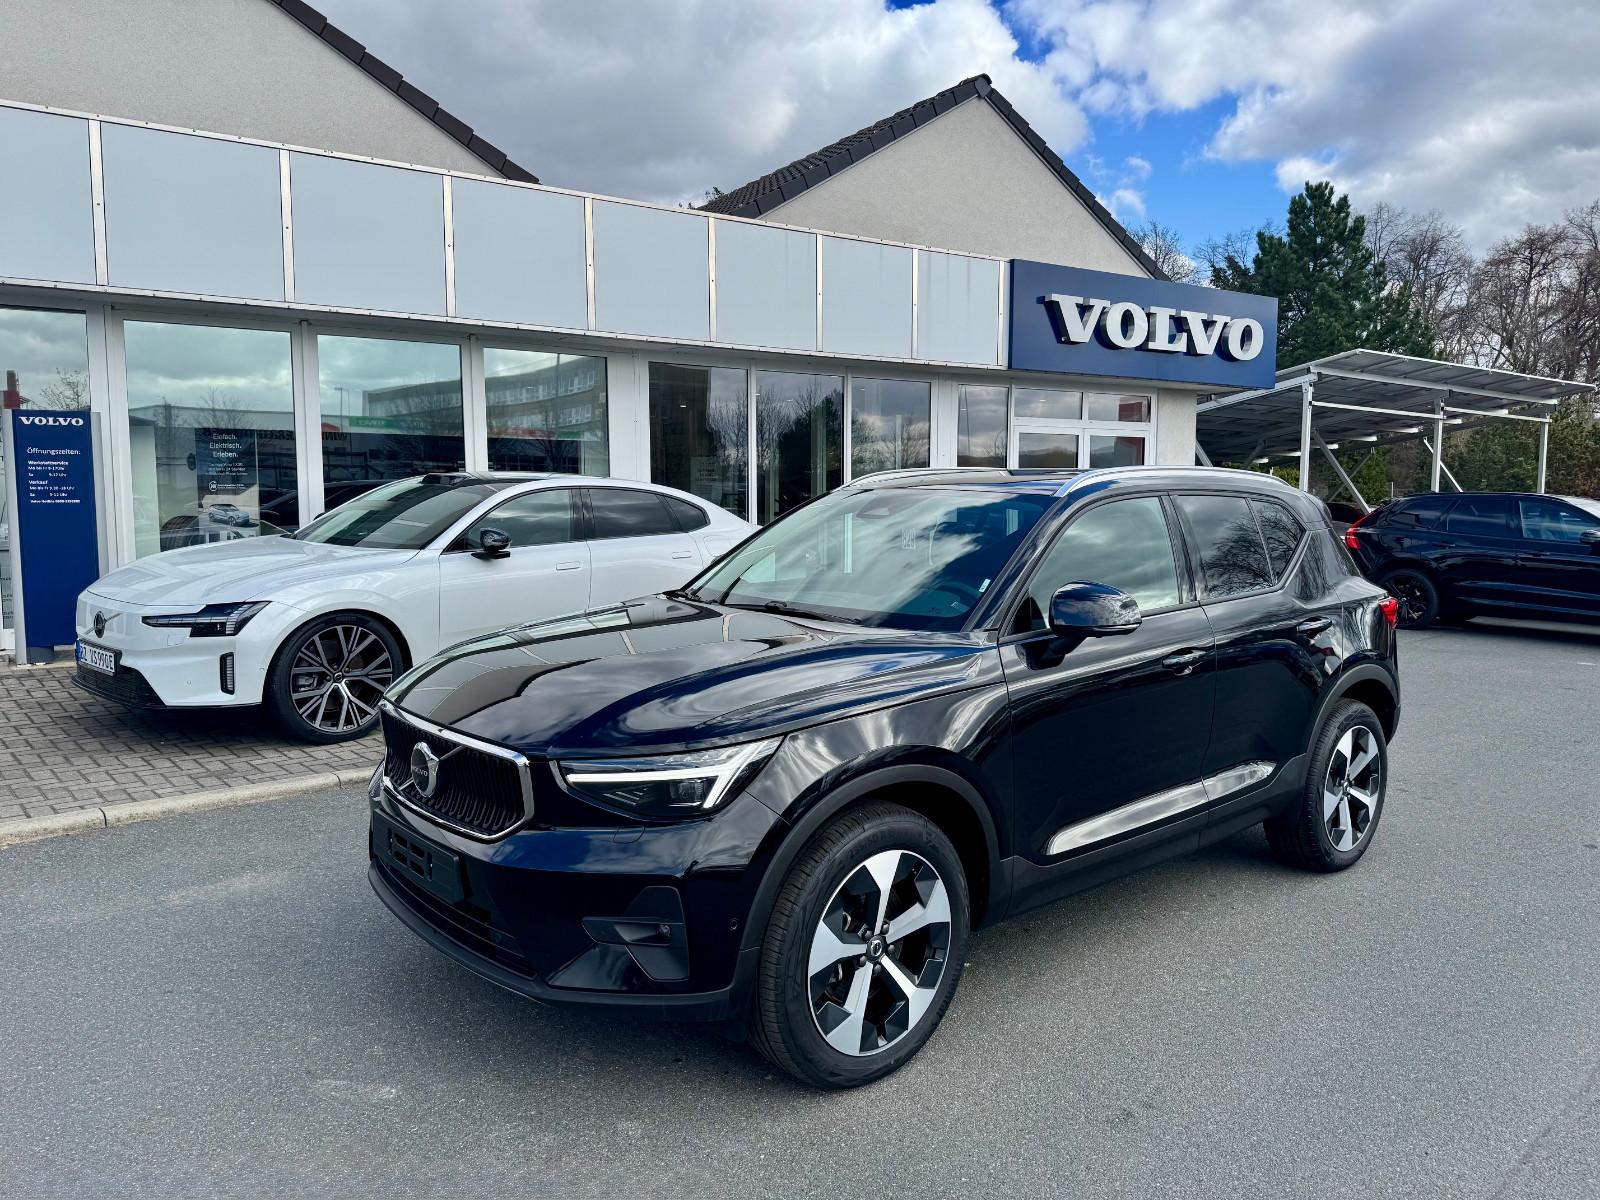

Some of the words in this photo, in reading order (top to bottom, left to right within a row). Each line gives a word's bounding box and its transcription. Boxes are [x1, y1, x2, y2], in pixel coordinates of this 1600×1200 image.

[1046, 293, 1265, 361] VOLVO
[19, 416, 84, 426] VOLVO
[27, 446, 80, 455] Öffnungszeiten:
[212, 450, 239, 458] Erleben.
